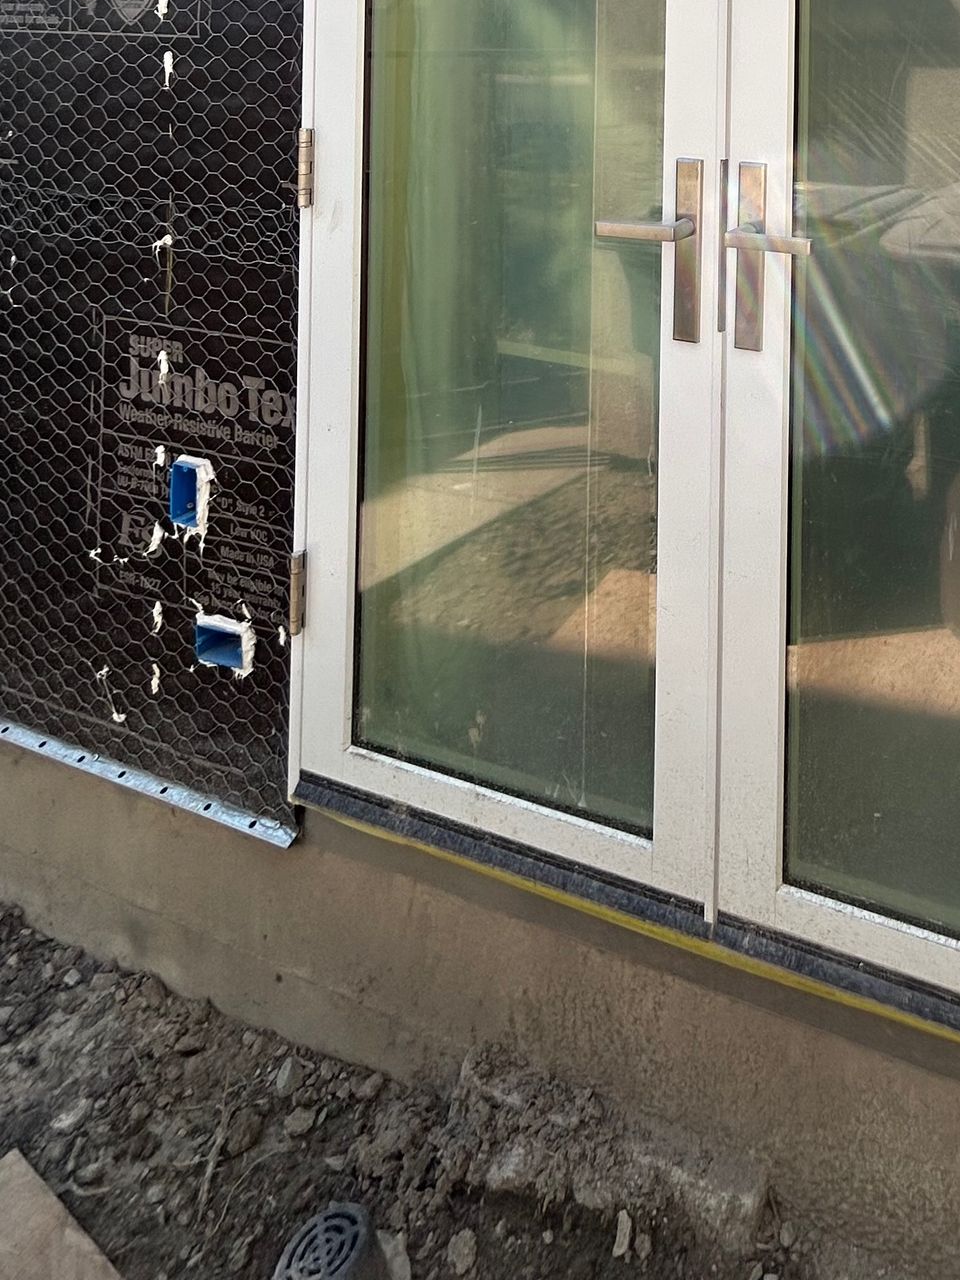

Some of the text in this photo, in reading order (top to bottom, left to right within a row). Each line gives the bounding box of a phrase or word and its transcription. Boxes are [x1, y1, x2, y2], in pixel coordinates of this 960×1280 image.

[129, 334, 184, 364] SUPER
[119, 357, 240, 418] Jumbo
[119, 403, 279, 449] Weather-Resistive Barrier
